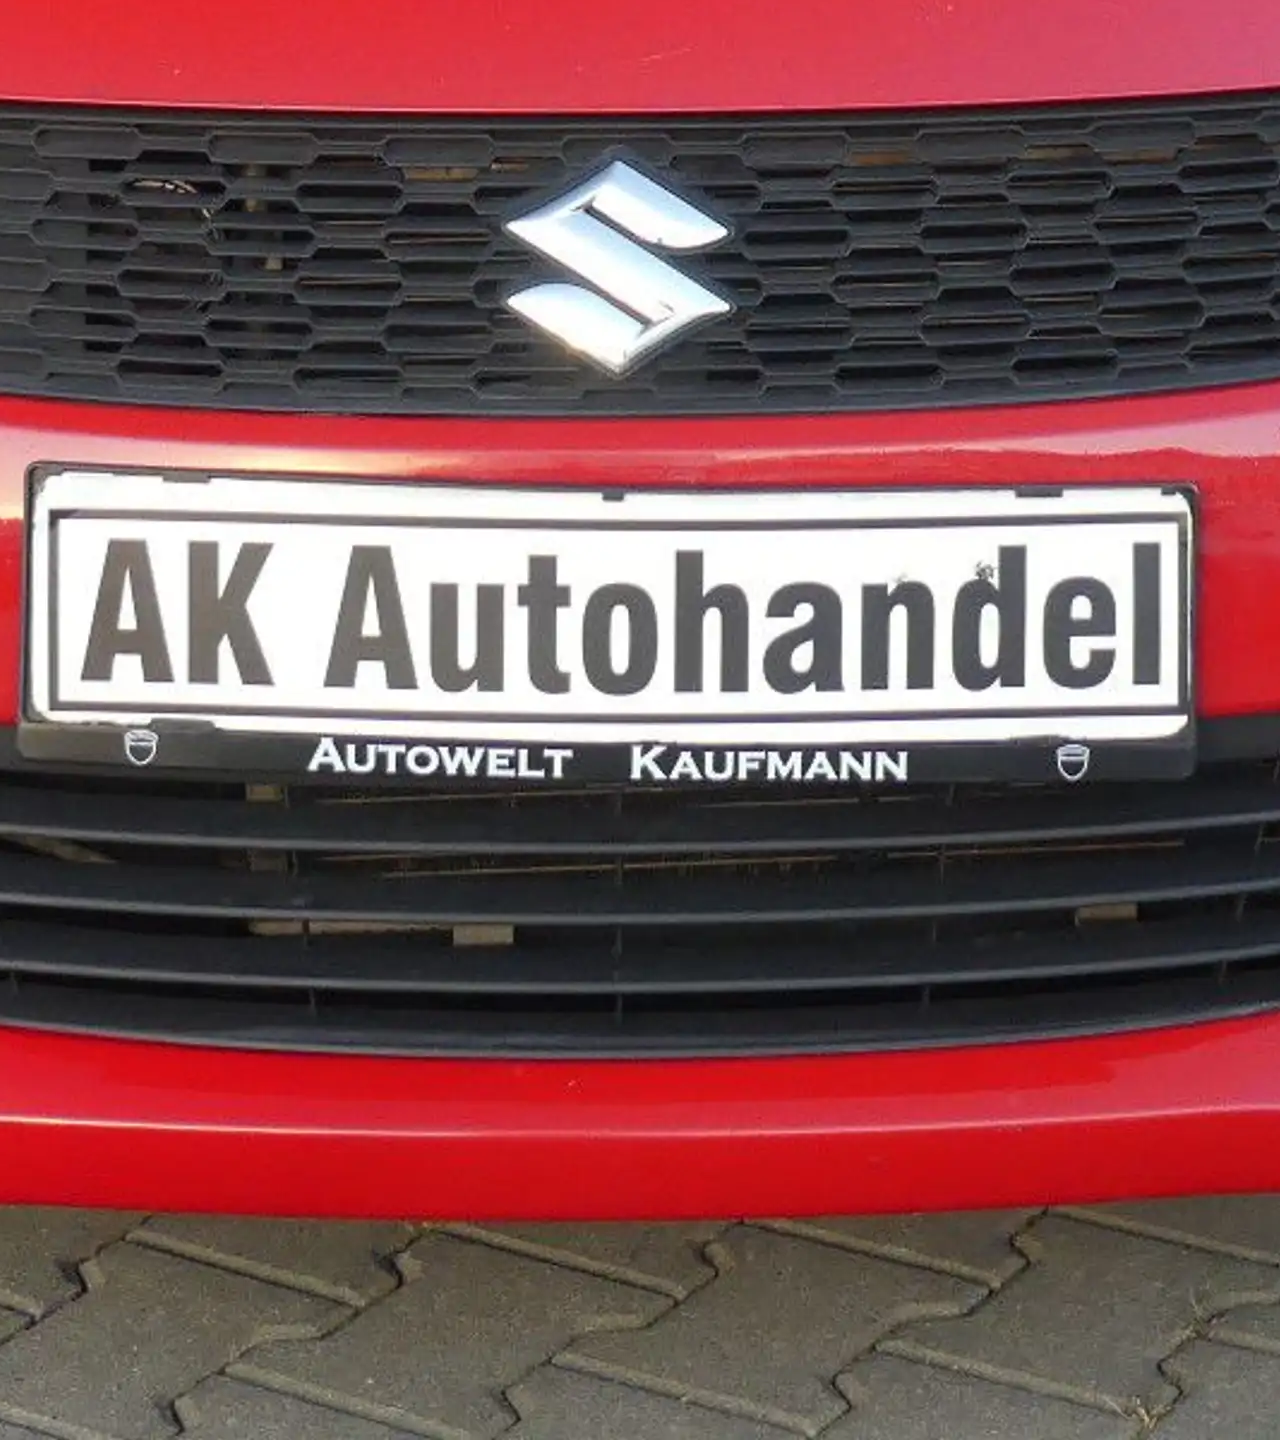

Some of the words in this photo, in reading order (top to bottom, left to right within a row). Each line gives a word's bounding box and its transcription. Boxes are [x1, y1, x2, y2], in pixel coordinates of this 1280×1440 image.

[81, 540, 274, 685] AK
[323, 542, 1161, 695] Autohandel
[307, 736, 574, 779] AUTOWELT
[630, 744, 908, 781] KAUFMANN
